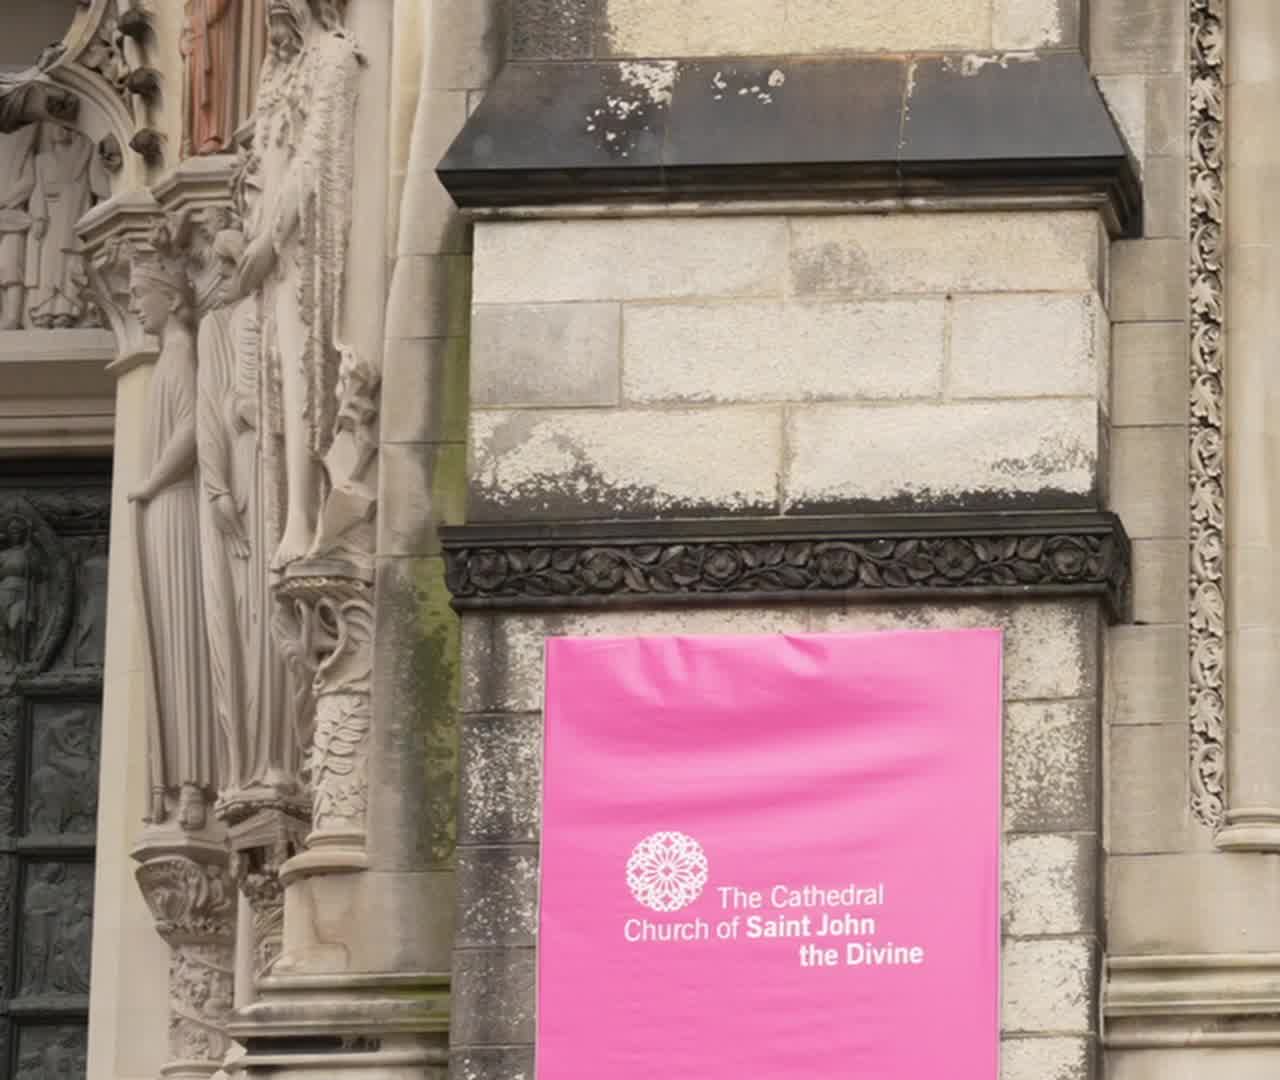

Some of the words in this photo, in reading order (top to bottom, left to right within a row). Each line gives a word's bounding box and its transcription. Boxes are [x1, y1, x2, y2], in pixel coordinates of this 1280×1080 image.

[717, 886, 762, 909] The
[770, 883, 885, 909] Cathedral
[623, 918, 709, 942] Church
[715, 915, 740, 940] of
[745, 914, 811, 939] Saint
[815, 912, 876, 938] John
[799, 943, 839, 968] the
[846, 942, 924, 966] Divine
